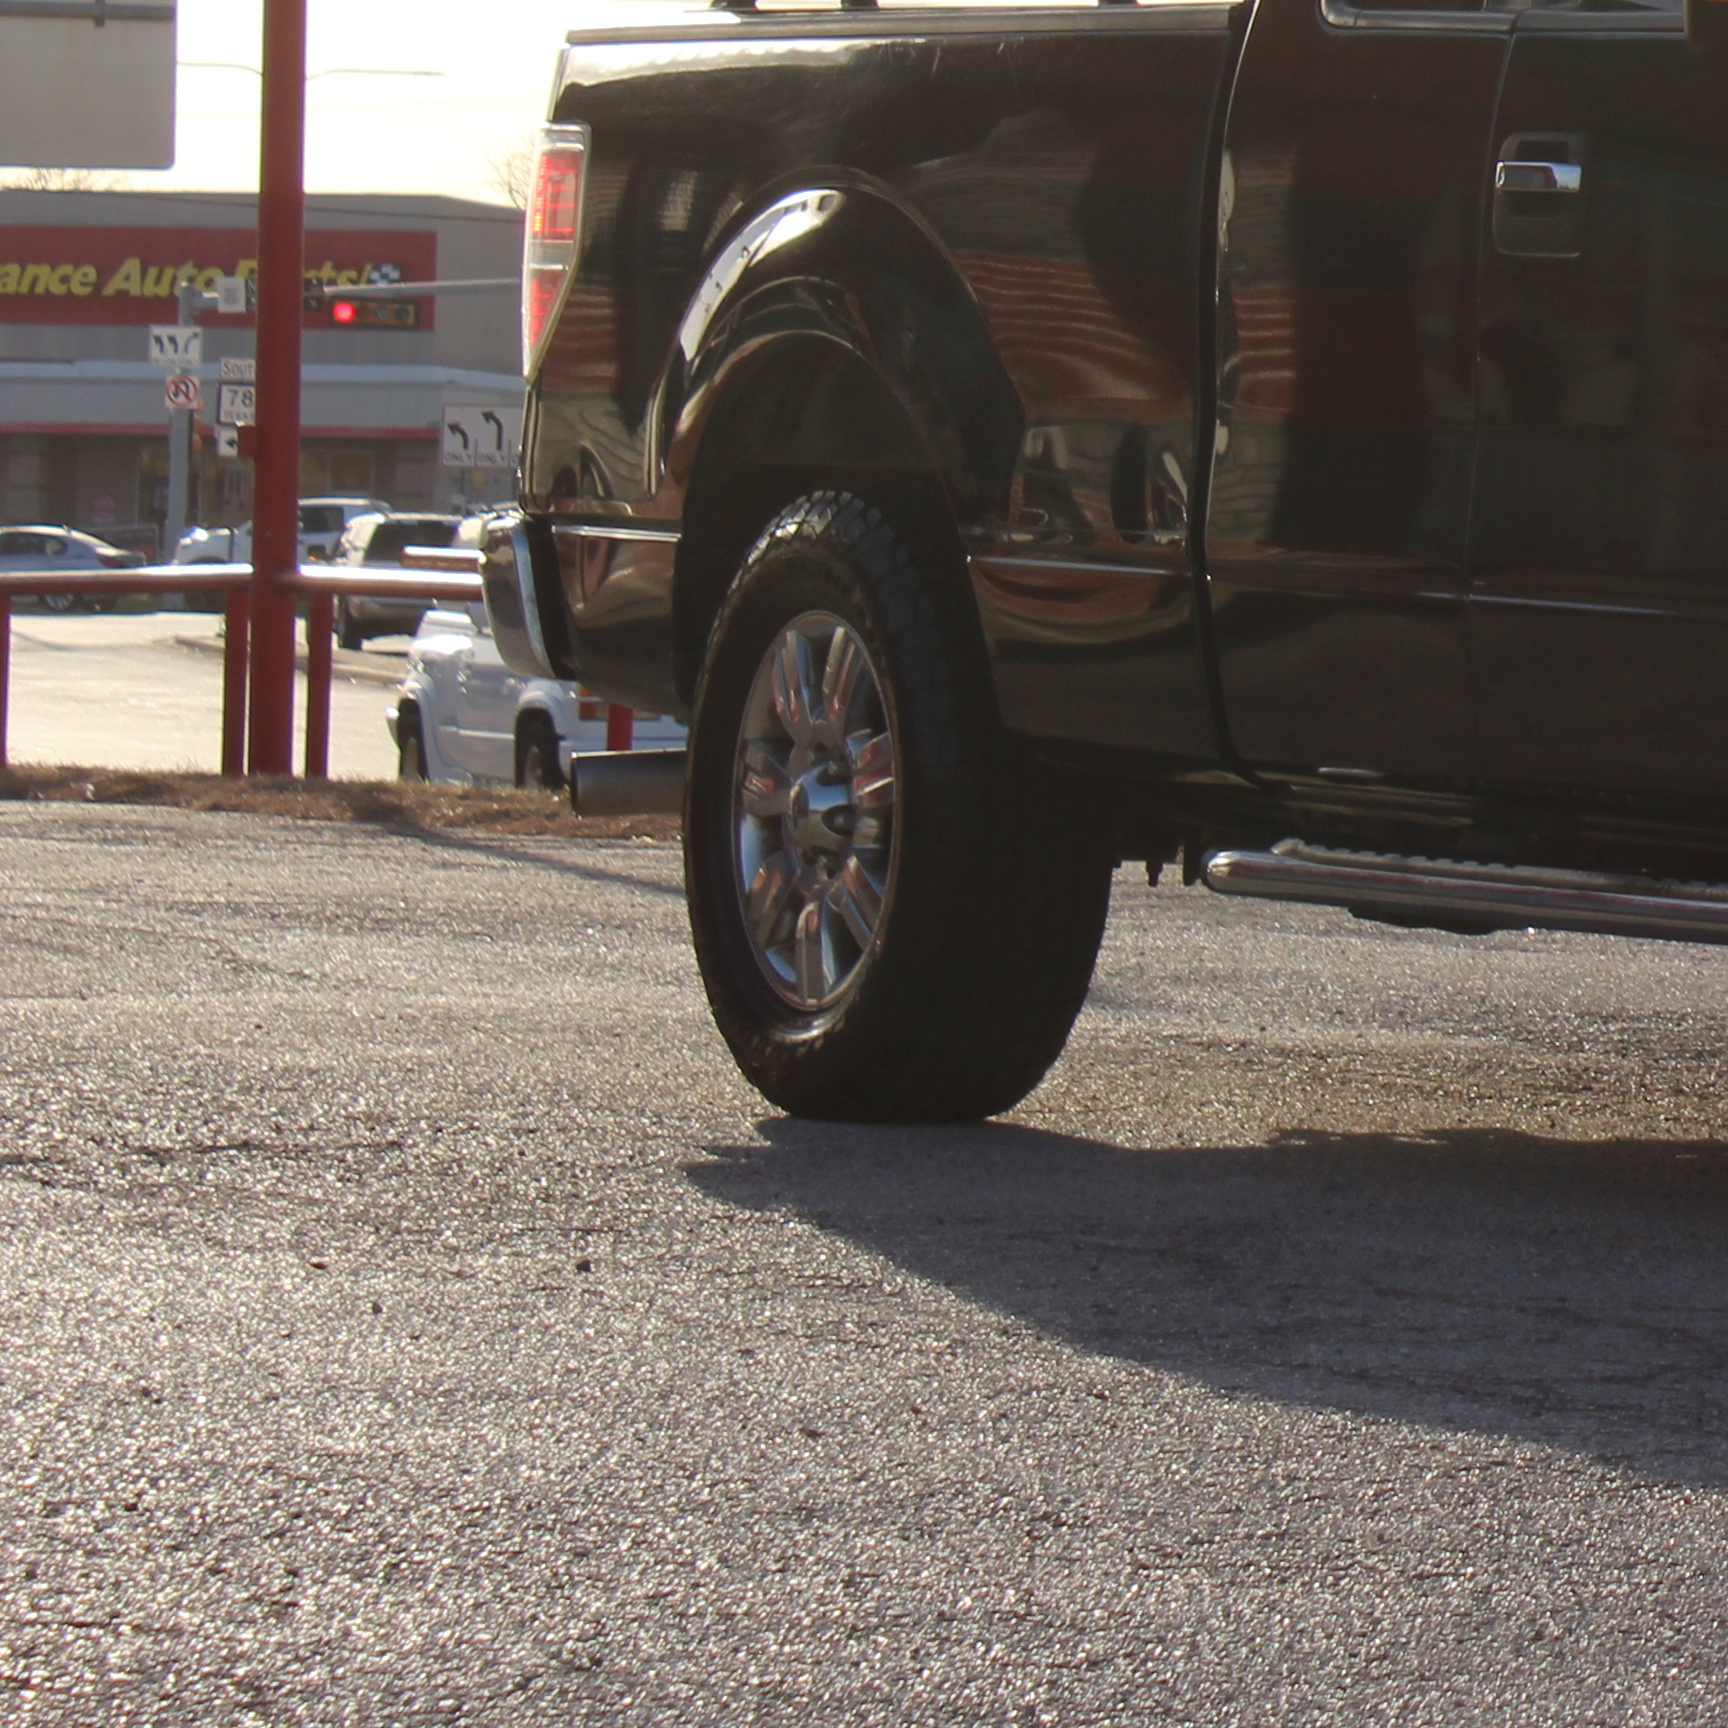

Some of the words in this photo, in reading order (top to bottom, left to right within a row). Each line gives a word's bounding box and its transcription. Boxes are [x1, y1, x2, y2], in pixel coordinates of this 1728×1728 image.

[101, 257, 225, 297] Auto
[223, 361, 254, 377] SOUT
[227, 389, 253, 408] 78
[445, 453, 473, 464] ONLY
[479, 454, 506, 465] ONLY
